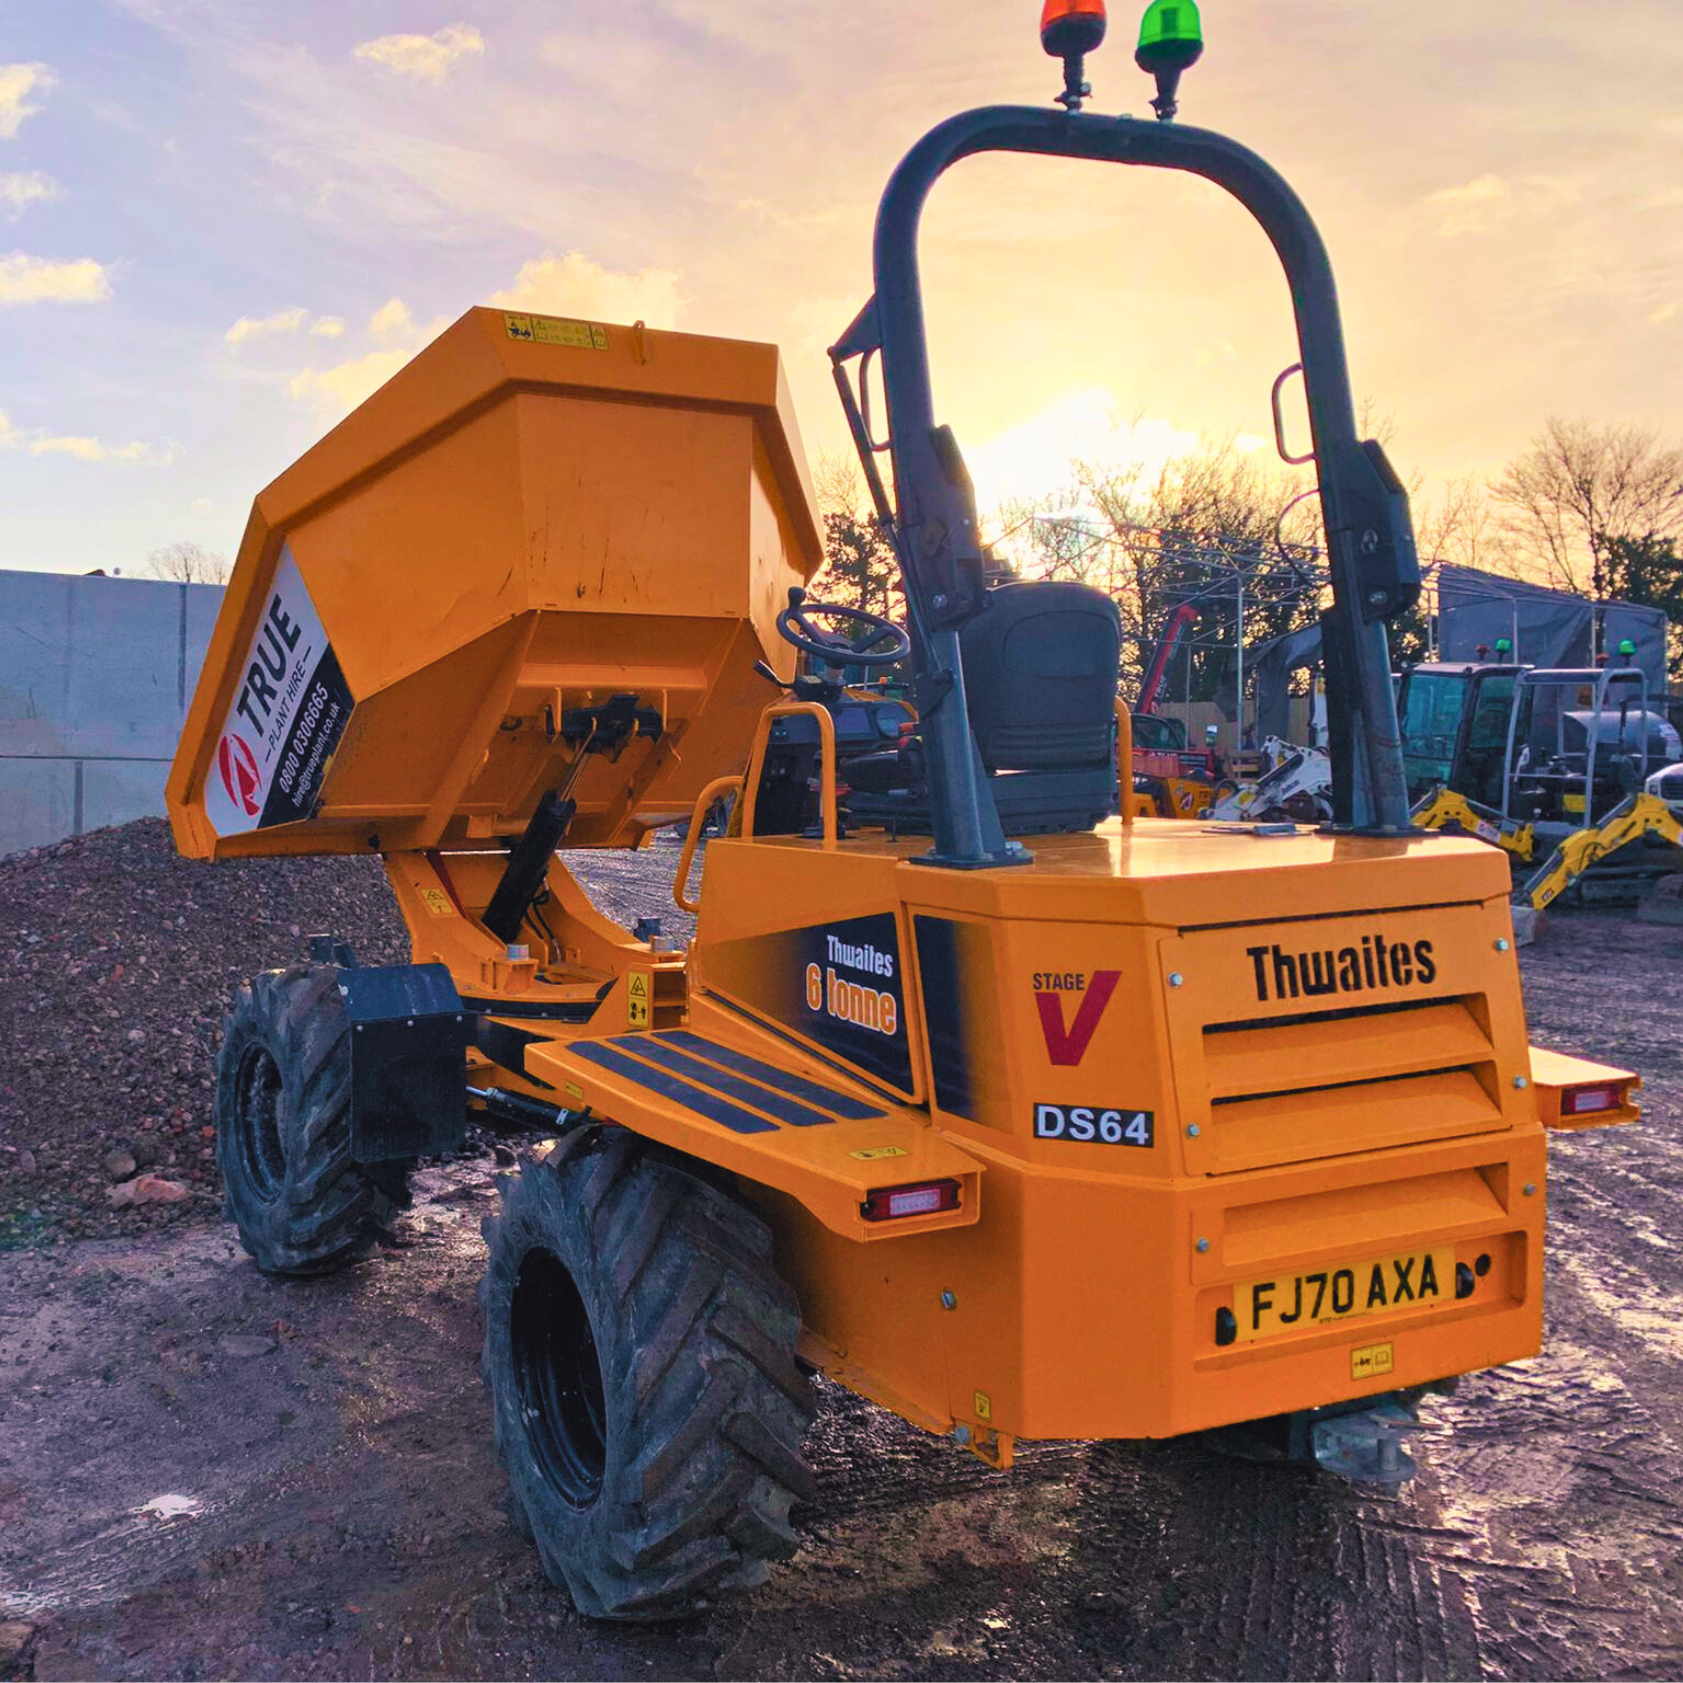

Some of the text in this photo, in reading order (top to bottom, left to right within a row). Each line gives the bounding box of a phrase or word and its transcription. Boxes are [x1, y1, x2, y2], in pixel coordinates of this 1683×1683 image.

[236, 593, 302, 738] TRUE
[268, 665, 306, 752] PLANT HIRE
[279, 681, 329, 794] 0800 0306665
[827, 935, 894, 978] Thwaites
[1032, 972, 1085, 992] STAGE
[1246, 933, 1438, 1002] Thwaites
[805, 962, 898, 1036] 6 tonne
[1034, 970, 1124, 1067] V
[1036, 1105, 1150, 1146] DS64
[1251, 1251, 1440, 1331] FJ70 AXA
